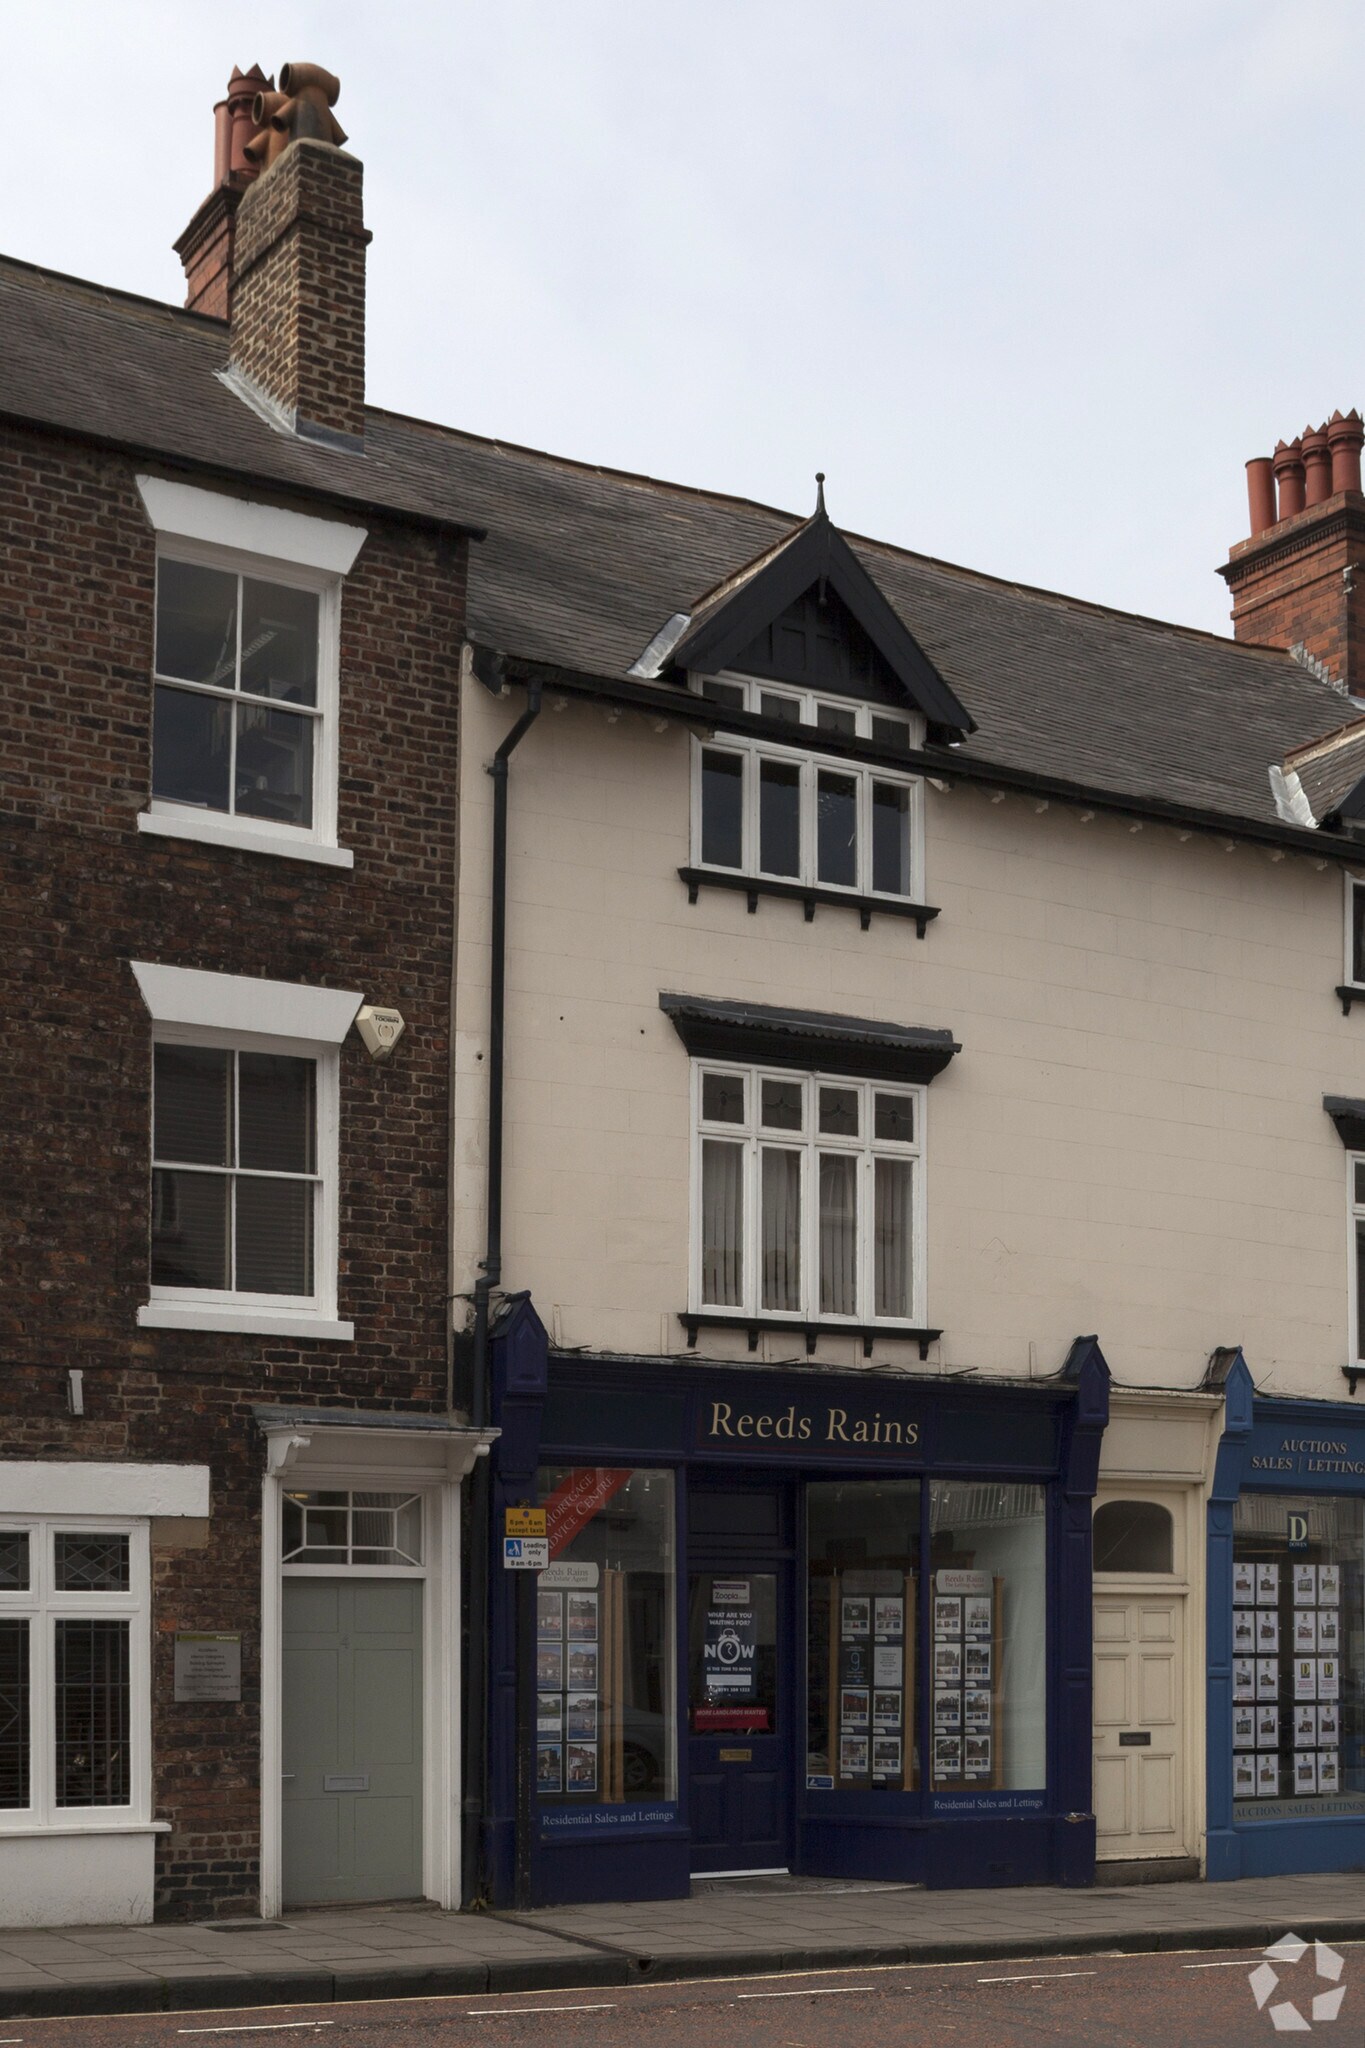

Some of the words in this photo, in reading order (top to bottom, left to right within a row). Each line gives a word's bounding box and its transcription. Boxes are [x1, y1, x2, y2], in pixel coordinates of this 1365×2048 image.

[708, 1402, 811, 1440] Reeds
[824, 1408, 919, 1445] Rains
[1281, 1439, 1348, 1455] AUCTIONS
[1252, 1456, 1293, 1470] SALES
[1308, 1459, 1365, 1474] LETTING
[576, 1475, 616, 1516] CENTRE
[1289, 1516, 1307, 1542] D
[704, 1638, 755, 1664] NOW
[934, 1800, 976, 1810] Residential
[977, 1800, 996, 1809] Sales
[998, 1798, 1012, 1808] and
[1014, 1798, 1044, 1809] Lettings
[1235, 1806, 1282, 1818] AUCTIONS
[1287, 1804, 1316, 1815] SALES
[542, 1813, 592, 1826] Residential
[595, 1813, 618, 1823] Sales
[620, 1812, 636, 1822] and
[638, 1810, 674, 1822] Lettings
